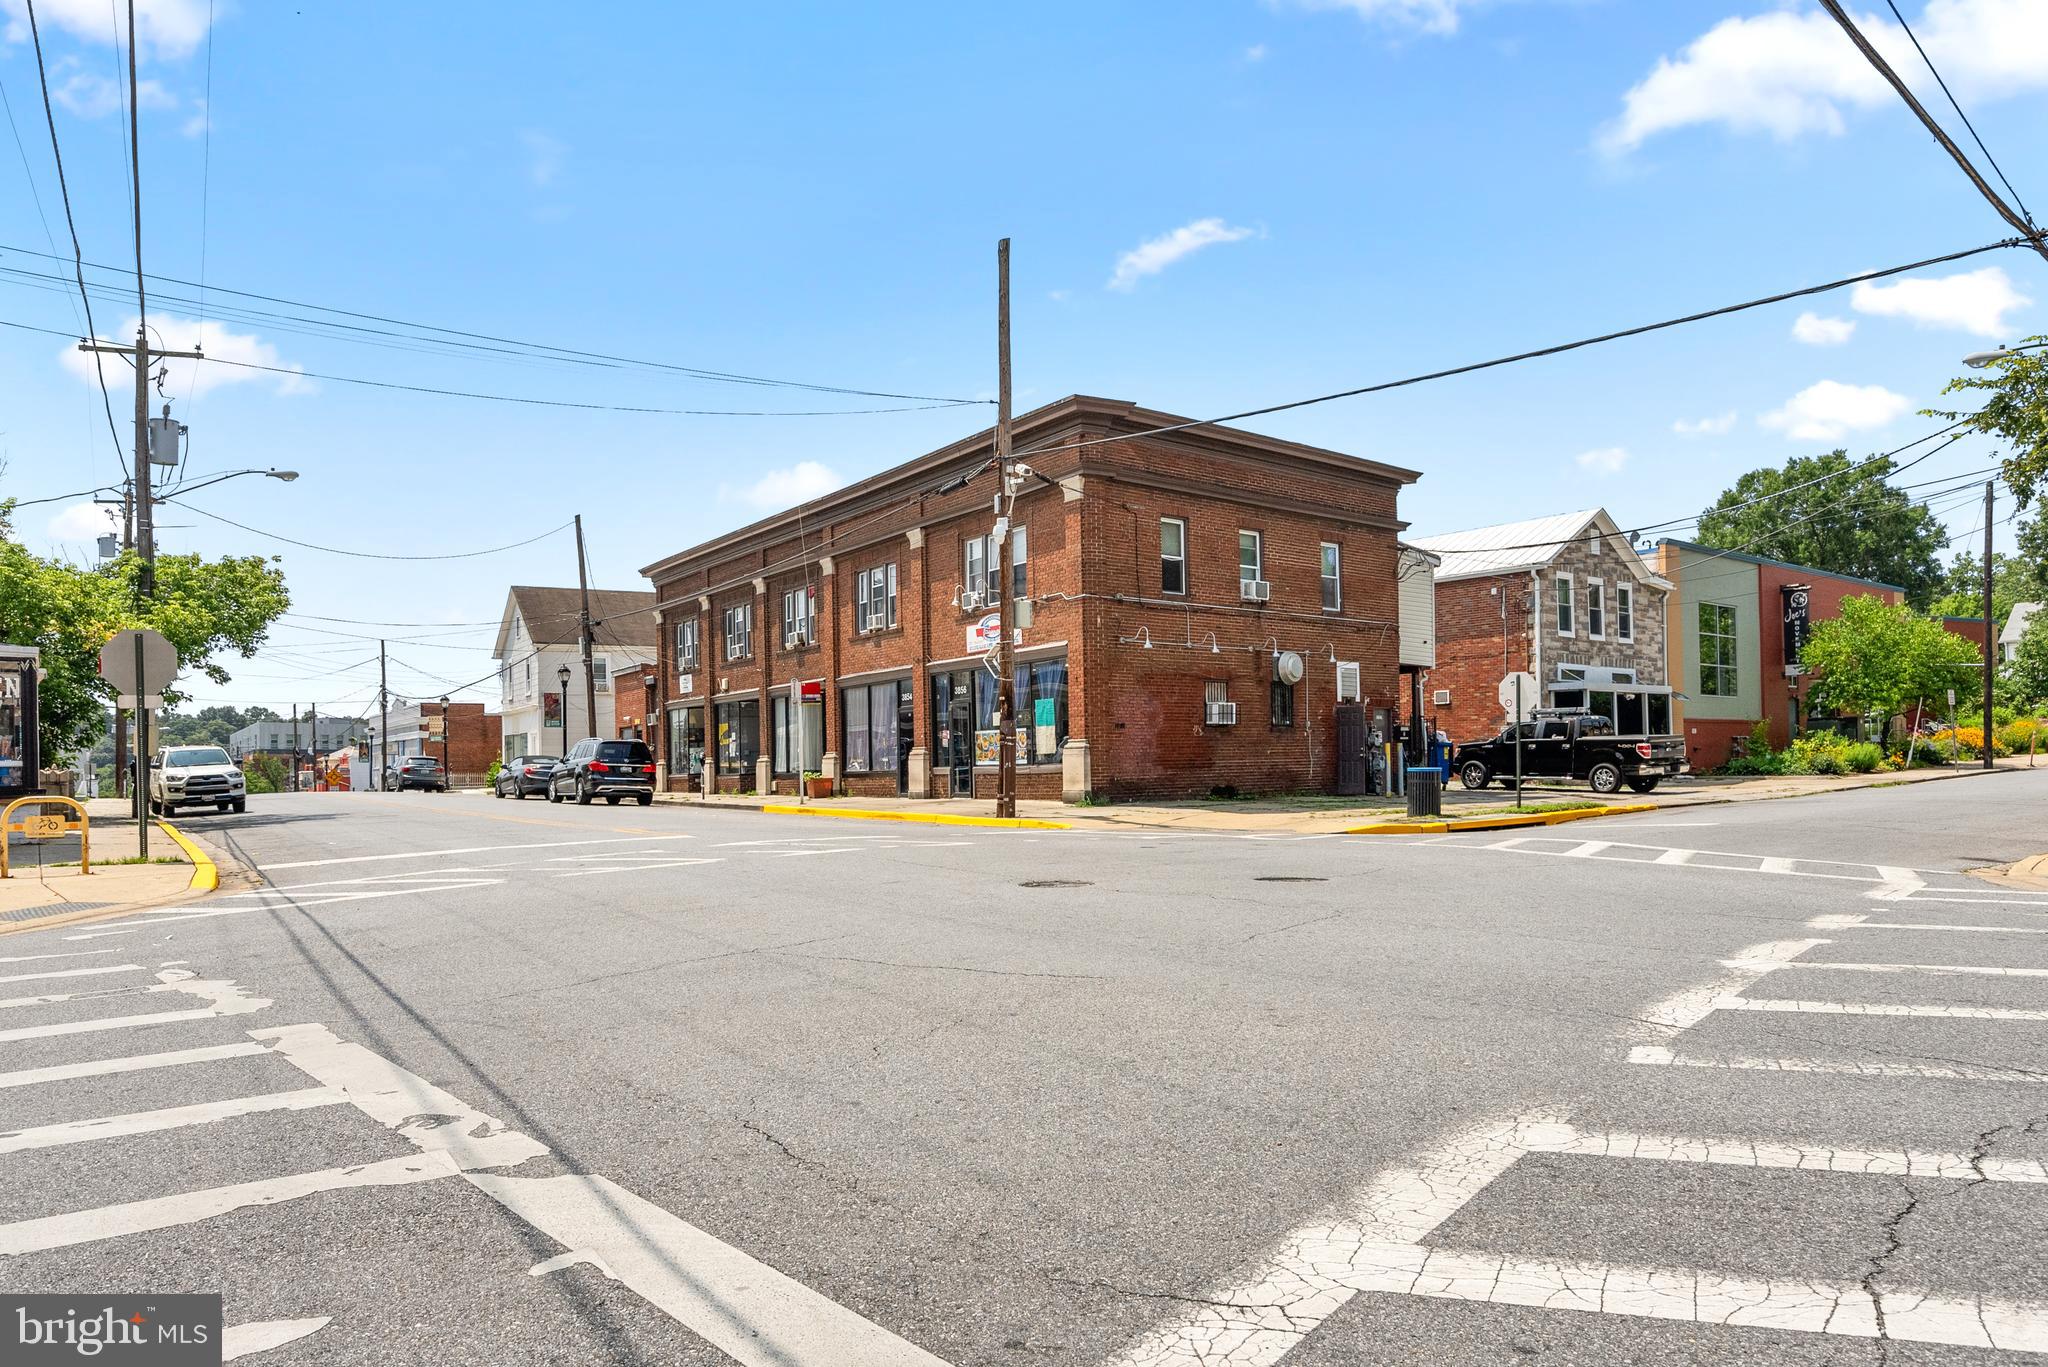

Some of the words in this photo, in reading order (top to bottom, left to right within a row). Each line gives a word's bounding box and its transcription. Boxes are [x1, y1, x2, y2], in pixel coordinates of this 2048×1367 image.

[1784, 608, 1806, 623] Joe's
[954, 685, 967, 695] 3856
[901, 692, 913, 701] 3854
